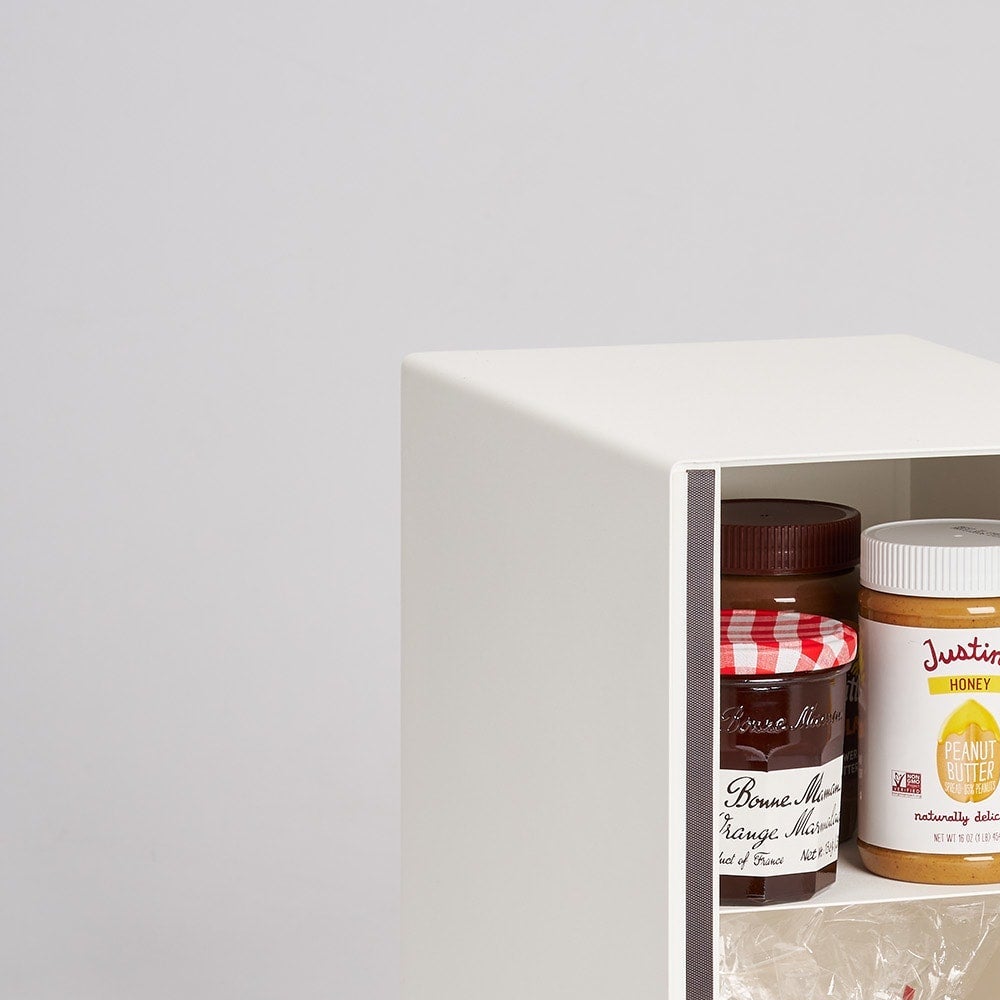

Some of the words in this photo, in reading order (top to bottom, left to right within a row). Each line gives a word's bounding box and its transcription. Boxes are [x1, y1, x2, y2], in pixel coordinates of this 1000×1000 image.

[949, 678, 991, 691] HONEY
[945, 740, 997, 760] PEANUT
[947, 761, 995, 782] BUTTER
[724, 776, 792, 808] Bonne
[914, 810, 970, 826] naturally
[933, 833, 945, 842] NET
[946, 833, 957, 842] WT
[966, 833, 973, 843] OZ
[738, 851, 750, 870] of
[753, 851, 785, 866] France
